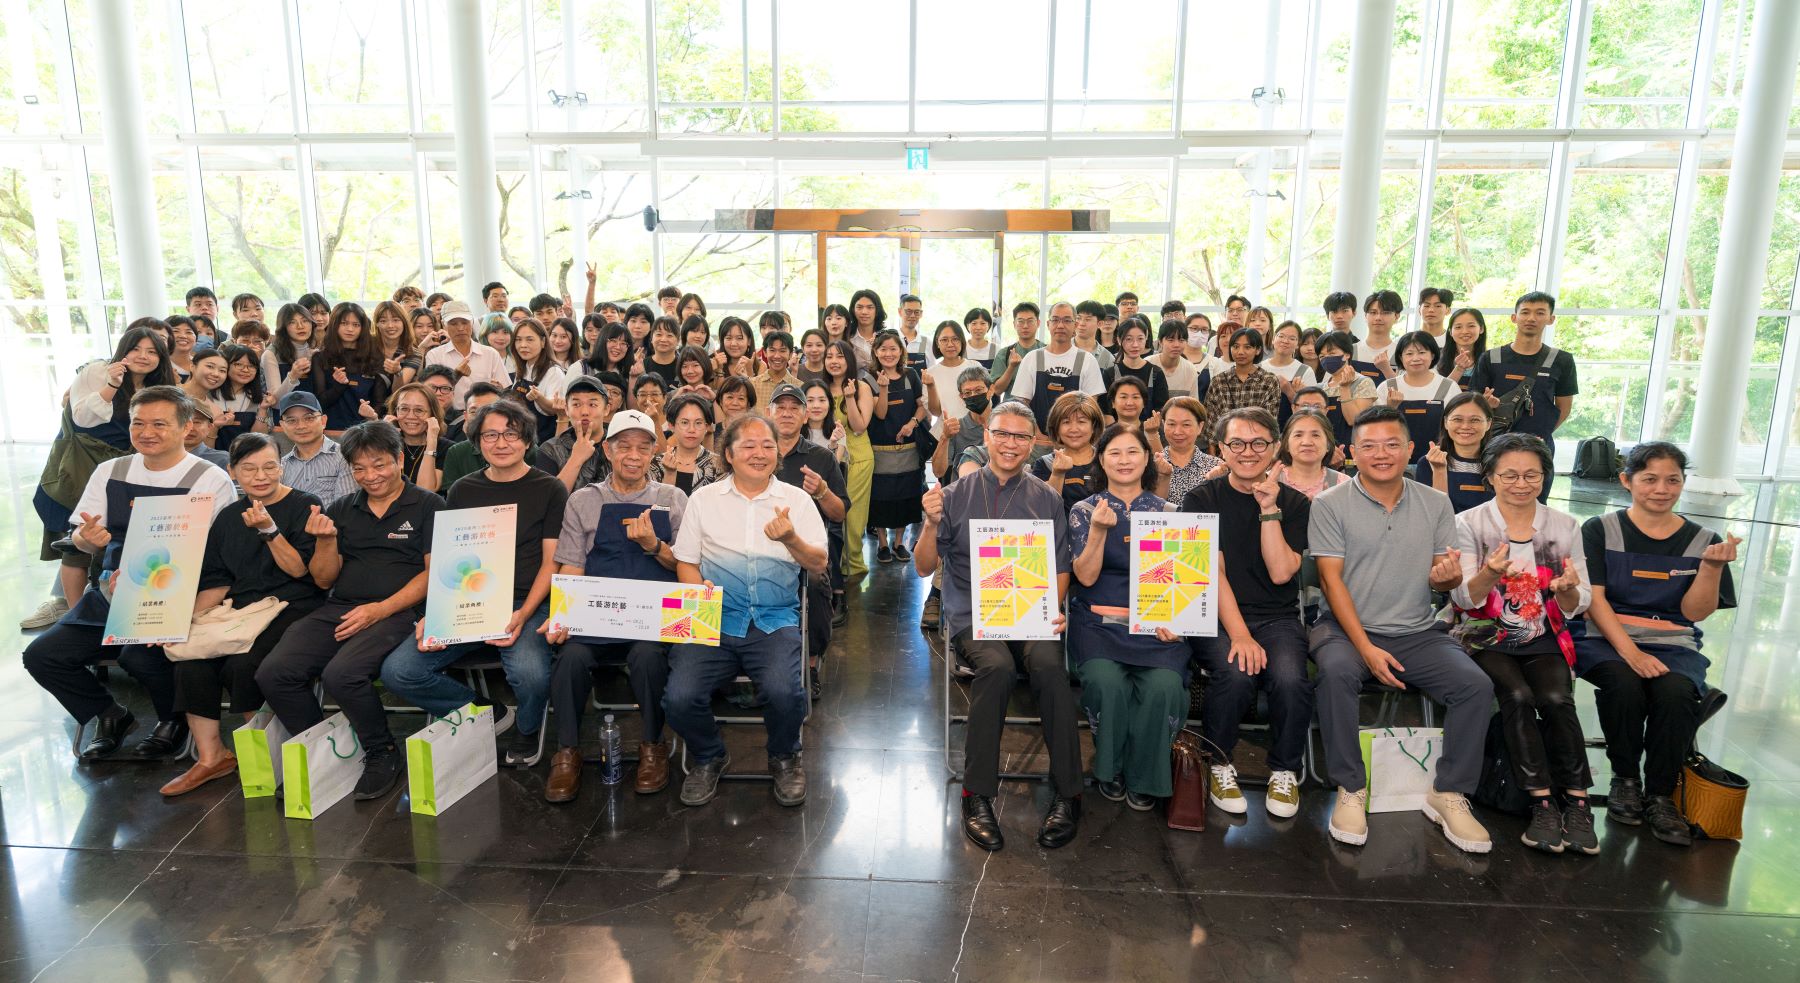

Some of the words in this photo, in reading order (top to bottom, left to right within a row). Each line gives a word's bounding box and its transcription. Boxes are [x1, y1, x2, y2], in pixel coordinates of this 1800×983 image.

[150, 522, 189, 532] 工藝游於藝
[455, 530, 496, 541] 工藝游於藝
[587, 600, 627, 610] 工藝游於藝
